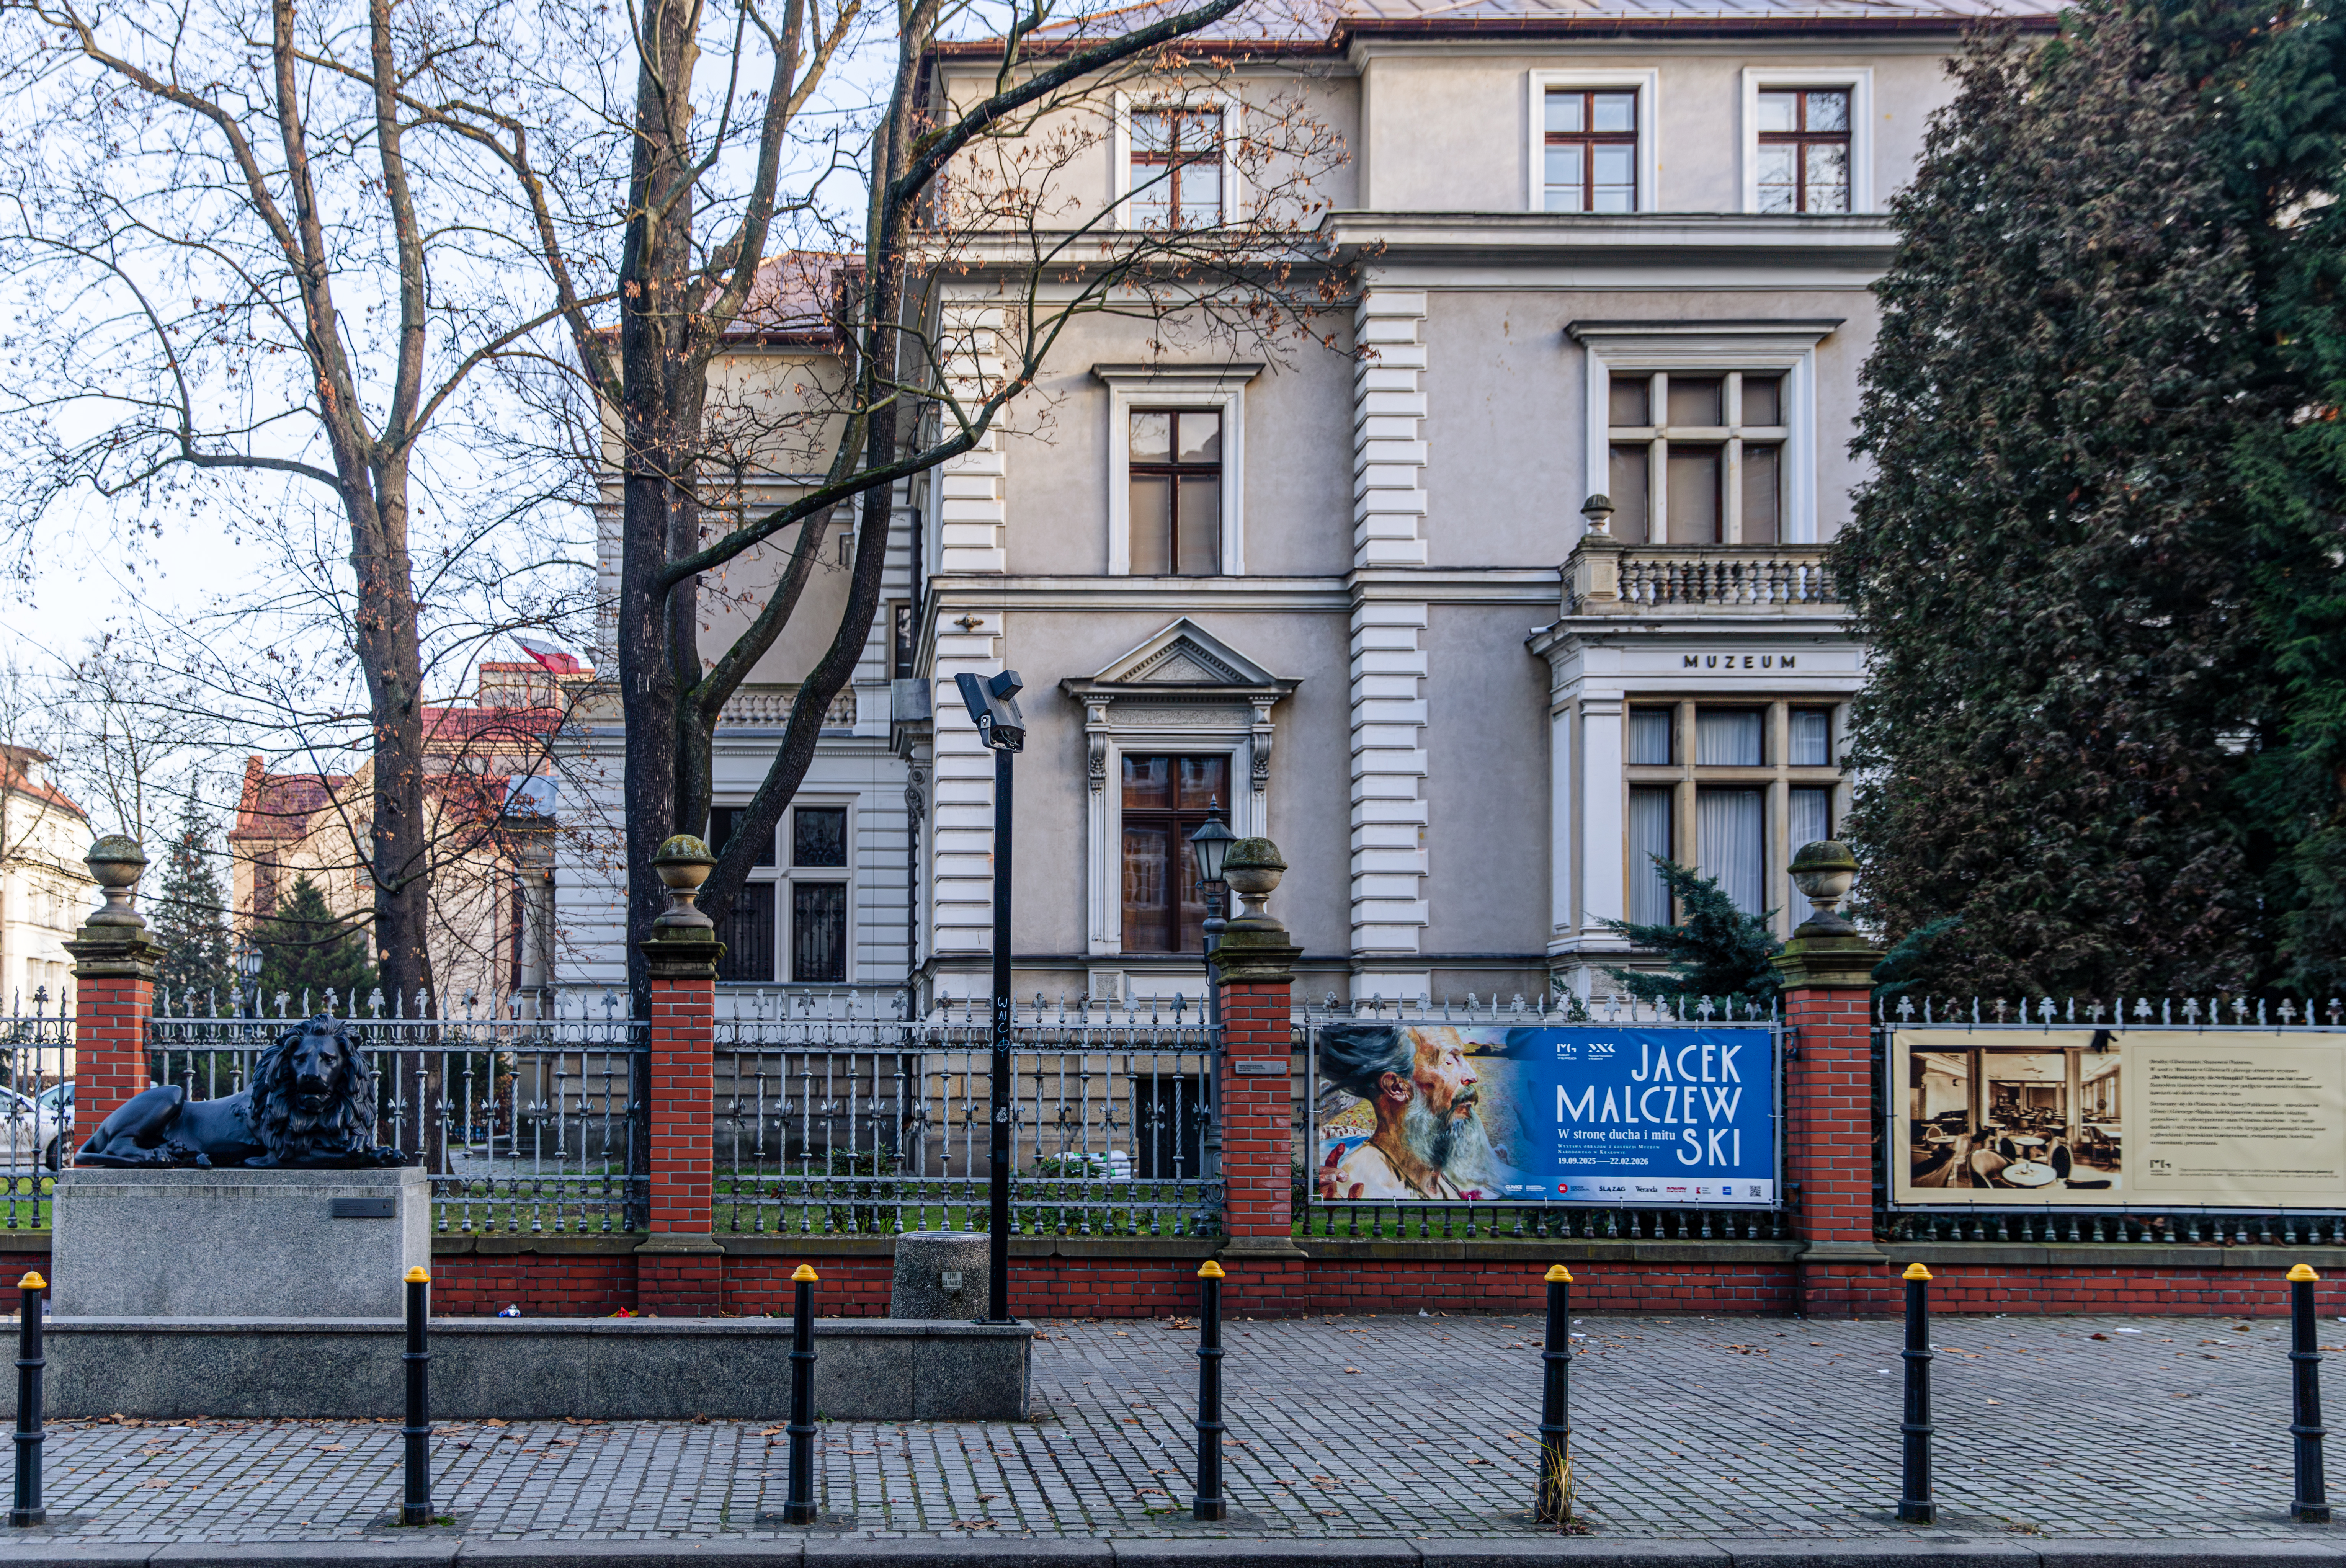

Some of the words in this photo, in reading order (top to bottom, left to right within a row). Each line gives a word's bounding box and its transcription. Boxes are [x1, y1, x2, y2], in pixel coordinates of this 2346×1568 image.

[1684, 655, 1795, 668] MUZEUM
[1631, 1044, 1742, 1083] JACEK
[1557, 1085, 1742, 1124] MALCZEW
[1558, 1129, 1570, 1139] W
[1573, 1130, 1606, 1142] stronę
[1609, 1129, 1640, 1140] ducha
[1644, 1130, 1648, 1140] i
[1651, 1130, 1675, 1140] mitu
[1676, 1128, 1740, 1166] SKI
